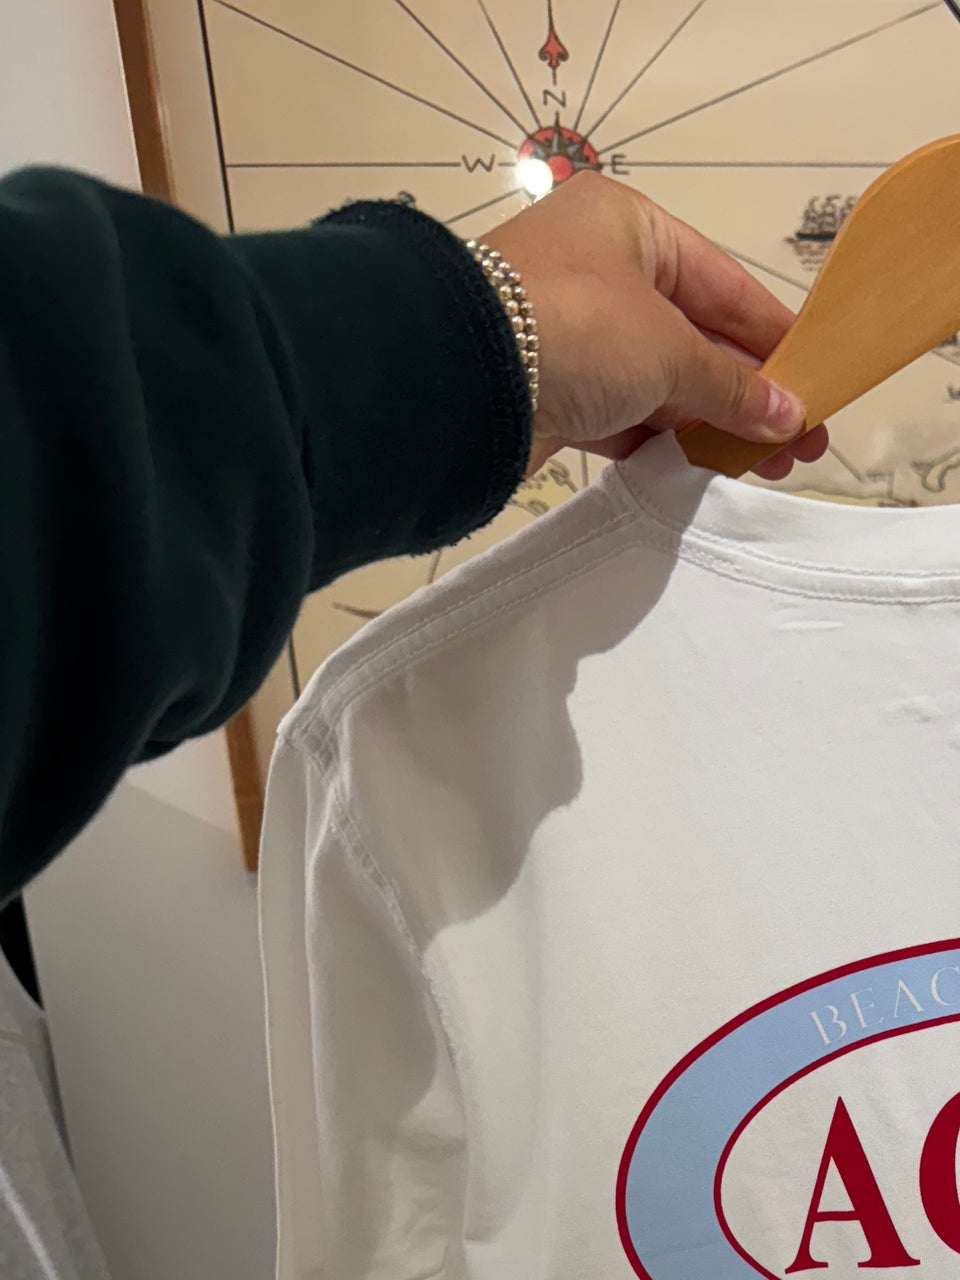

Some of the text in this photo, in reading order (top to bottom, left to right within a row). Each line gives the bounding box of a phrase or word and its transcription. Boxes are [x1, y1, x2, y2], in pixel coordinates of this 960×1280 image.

[543, 89, 566, 108] N
[462, 154, 495, 173] W
[611, 154, 630, 175] E
